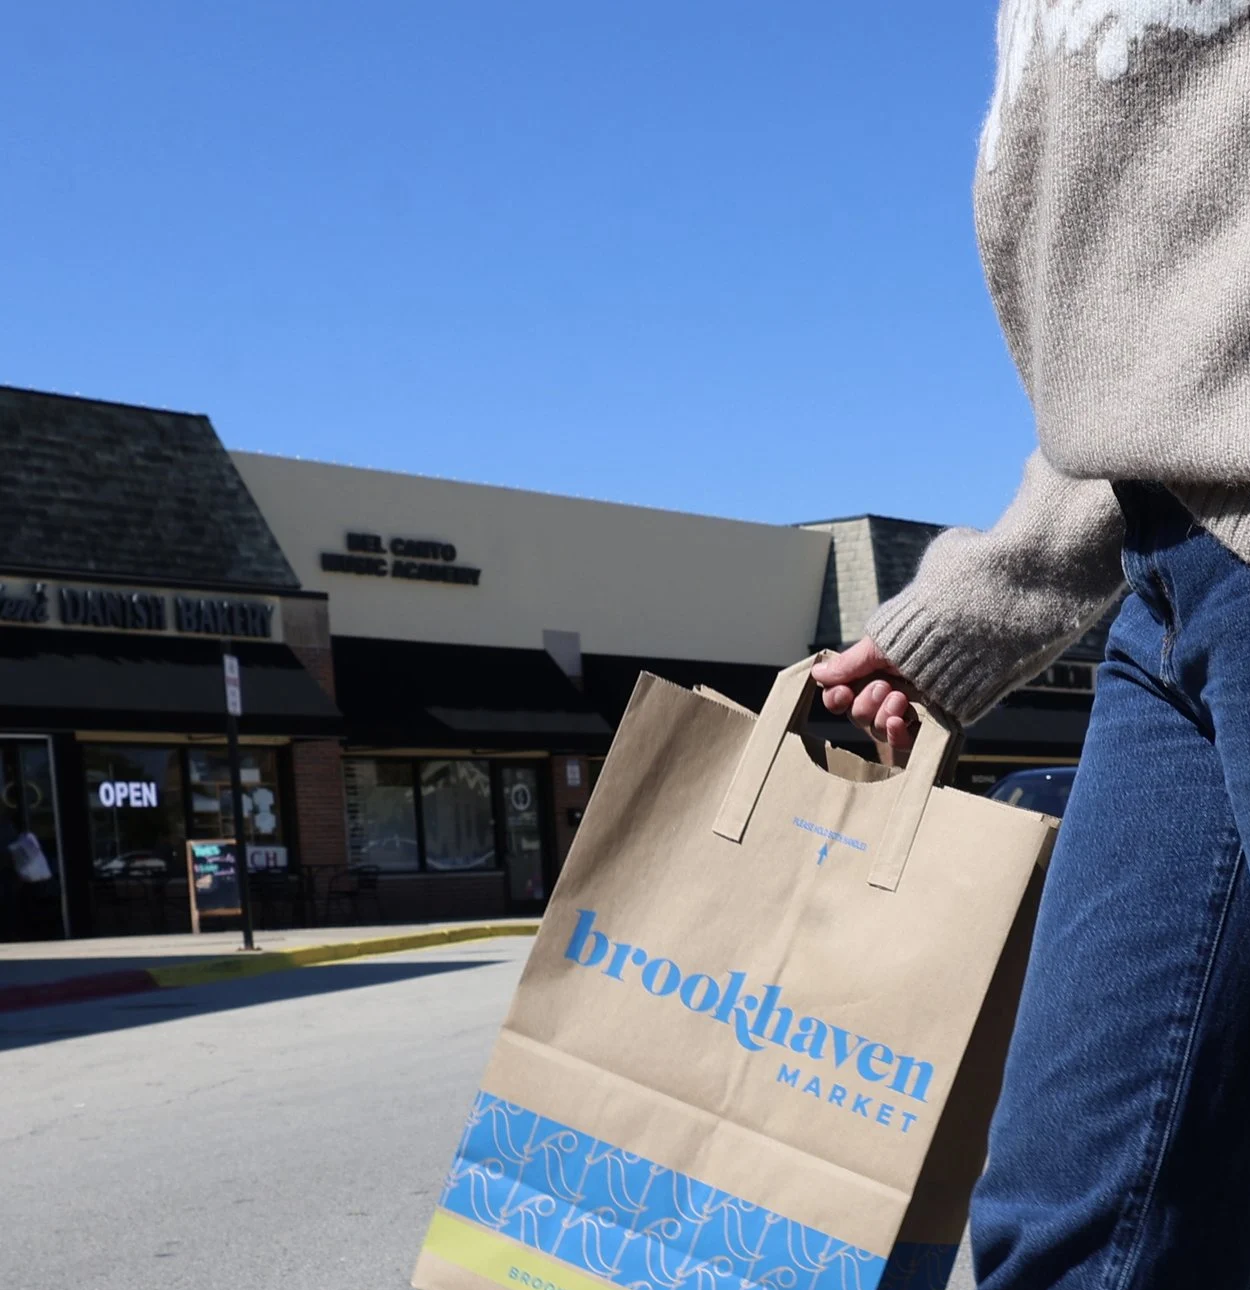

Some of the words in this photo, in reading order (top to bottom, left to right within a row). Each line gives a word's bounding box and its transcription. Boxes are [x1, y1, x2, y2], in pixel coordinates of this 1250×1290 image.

[60, 587, 168, 631] DANISH
[175, 594, 275, 638] BAKERY
[99, 781, 158, 808] OPEN
[563, 909, 935, 1103] brookhaven
[776, 1065, 918, 1133] MARKET
